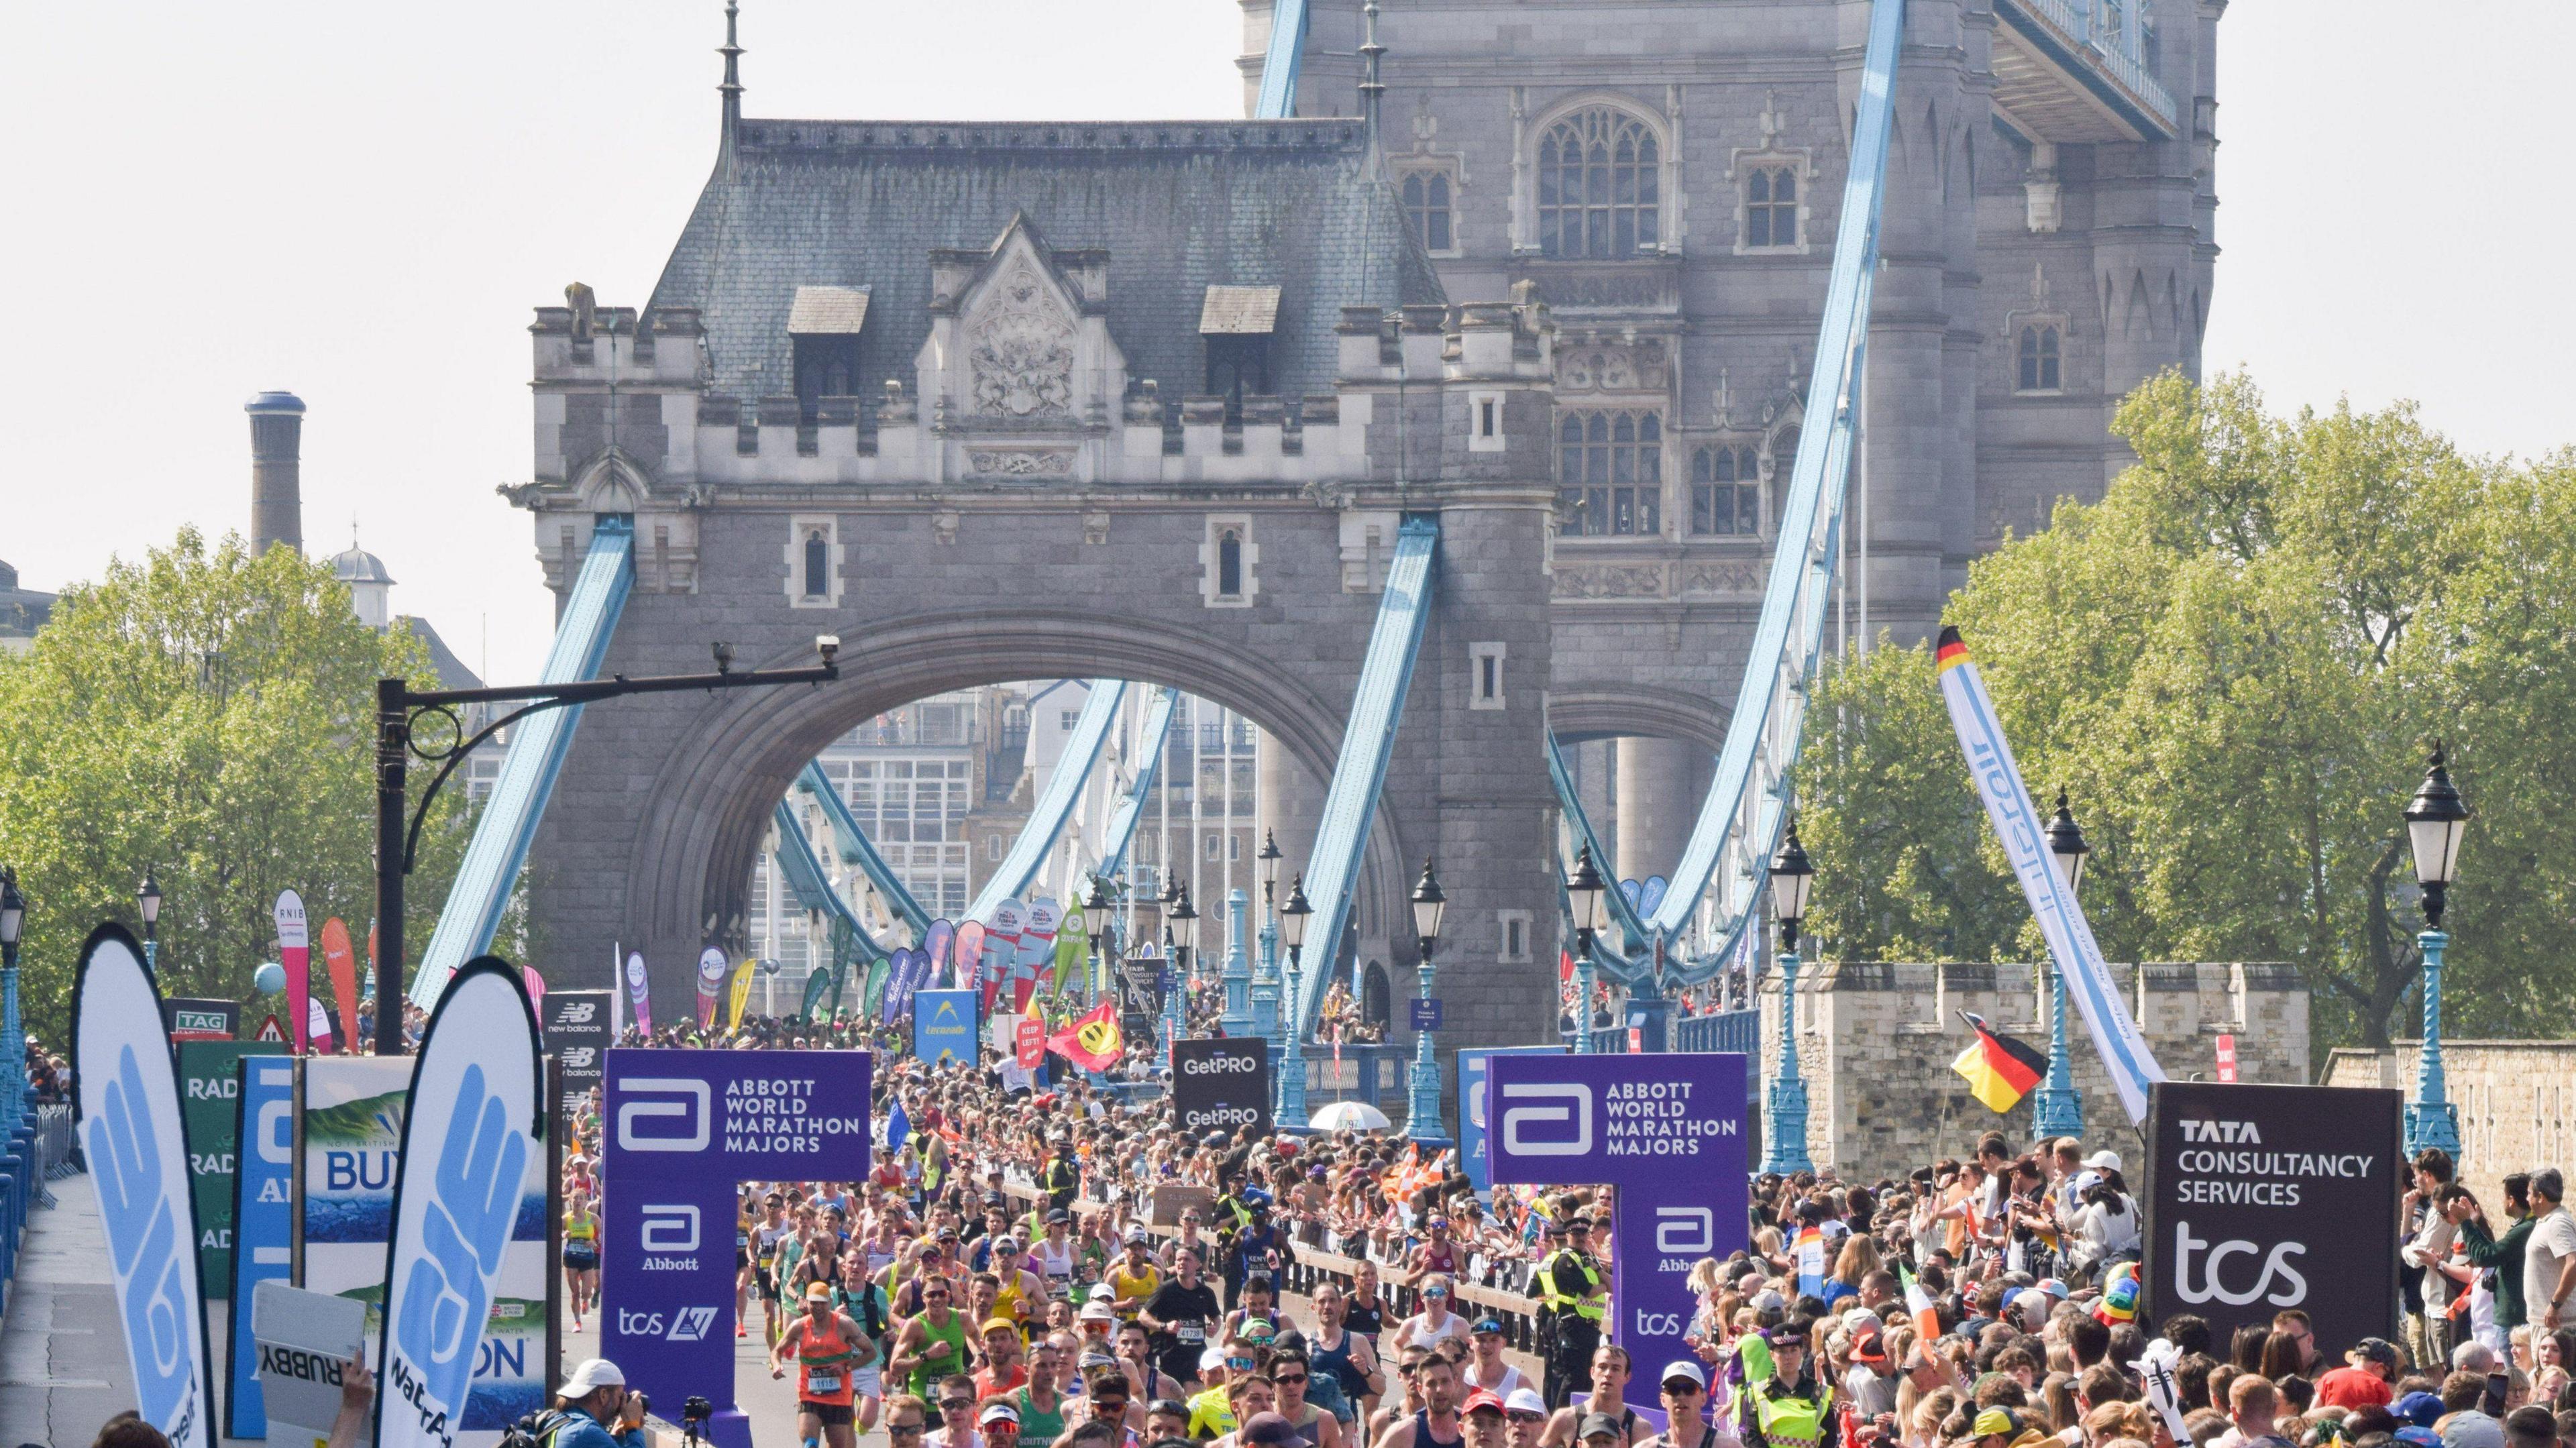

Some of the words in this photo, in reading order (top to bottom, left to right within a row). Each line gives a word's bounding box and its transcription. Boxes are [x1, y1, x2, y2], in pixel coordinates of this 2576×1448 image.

[280, 909, 304, 919] RNIB
[181, 1014, 223, 1028] TAG
[567, 1025, 602, 1033] balance
[1022, 1026, 1039, 1035] KEEP
[567, 1069, 602, 1077] balance
[1184, 1056, 1256, 1075] GetPRO
[725, 1079, 816, 1096] ABBOTT
[1606, 1082, 1693, 1099] ABBOTT
[725, 1098, 807, 1115] WORLD
[1606, 1101, 1685, 1117] WORLD
[1186, 1108, 1258, 1126] GetPRO
[725, 1117, 859, 1135] MARATHON
[1606, 1119, 1737, 1137] MARATHON
[2179, 1119, 2261, 1144] TATA
[725, 1136, 820, 1153] MAJORS
[1606, 1139, 1699, 1156] MAJORS
[2178, 1150, 2374, 1178] CONSULTANCY
[2178, 1180, 2300, 1206] SERVICES
[642, 1258, 699, 1271] Abbott
[2176, 1221, 2307, 1307] tcs
[619, 1307, 663, 1335] tcs
[1637, 1308, 1680, 1335] tcs
